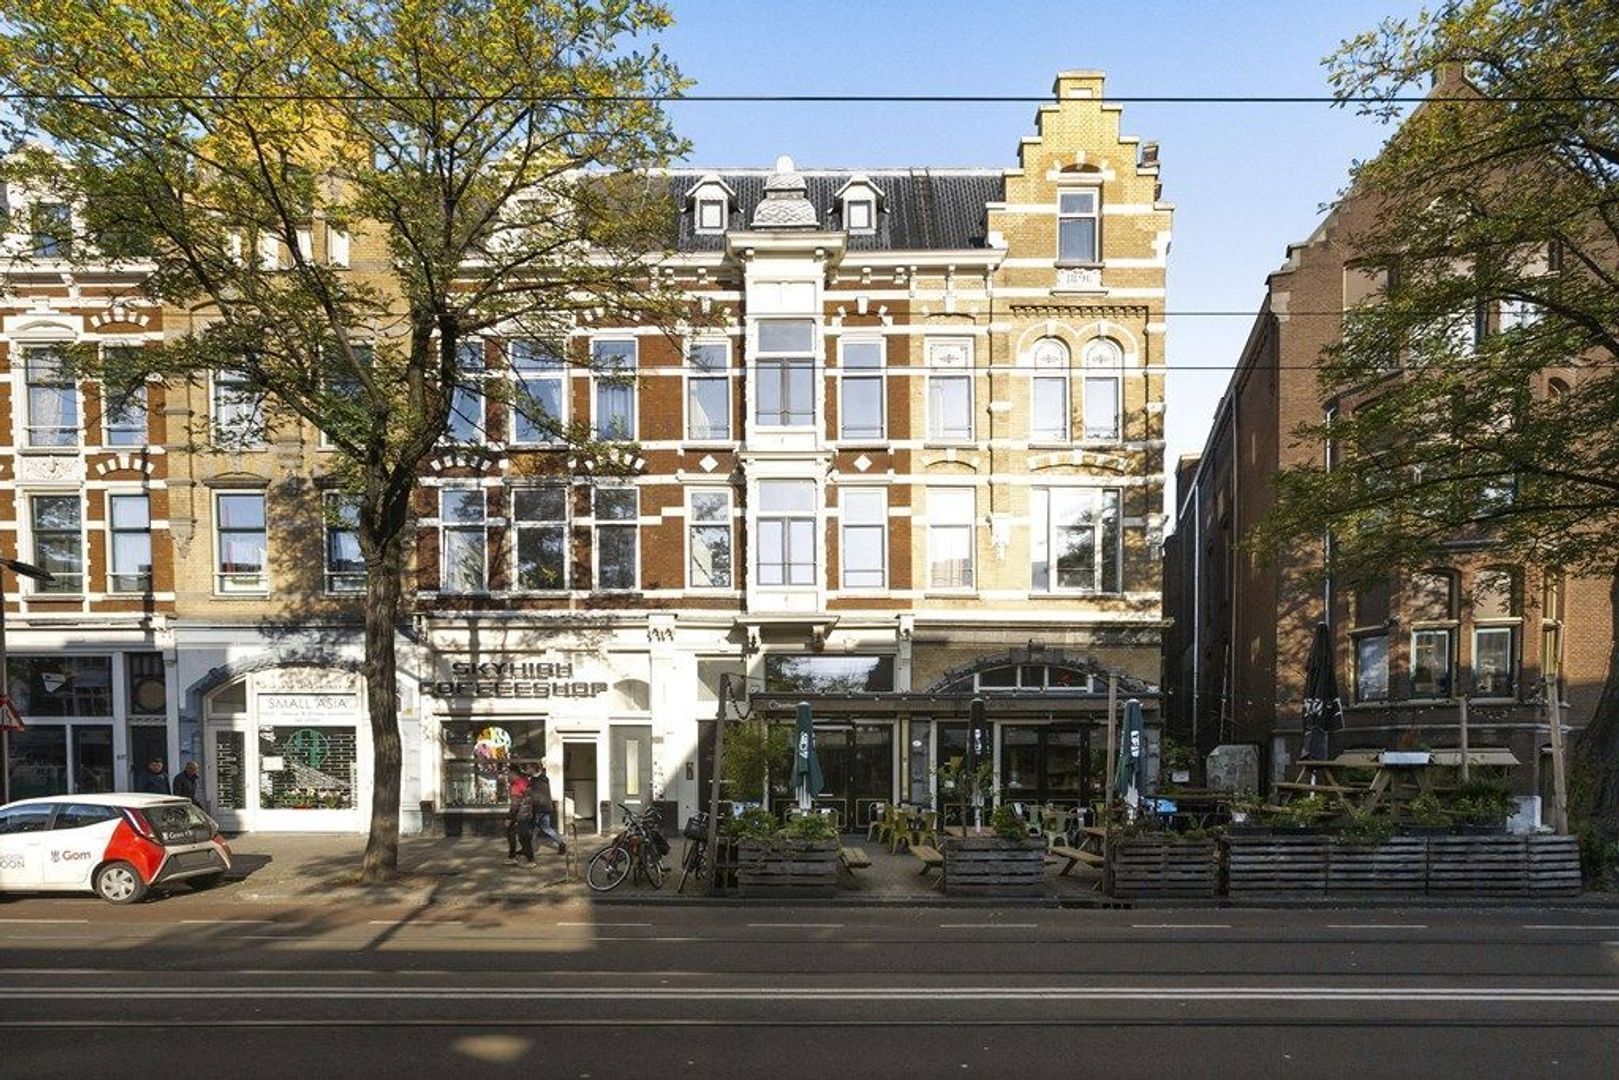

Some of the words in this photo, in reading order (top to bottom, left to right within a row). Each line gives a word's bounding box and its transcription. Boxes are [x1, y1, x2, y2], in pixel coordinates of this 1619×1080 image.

[452, 662, 574, 678] SKYHIGH
[418, 681, 608, 698] COFFEESHOP
[268, 697, 311, 709] SMALL
[316, 697, 348, 709] ASIA
[62, 850, 91, 861] Gom
